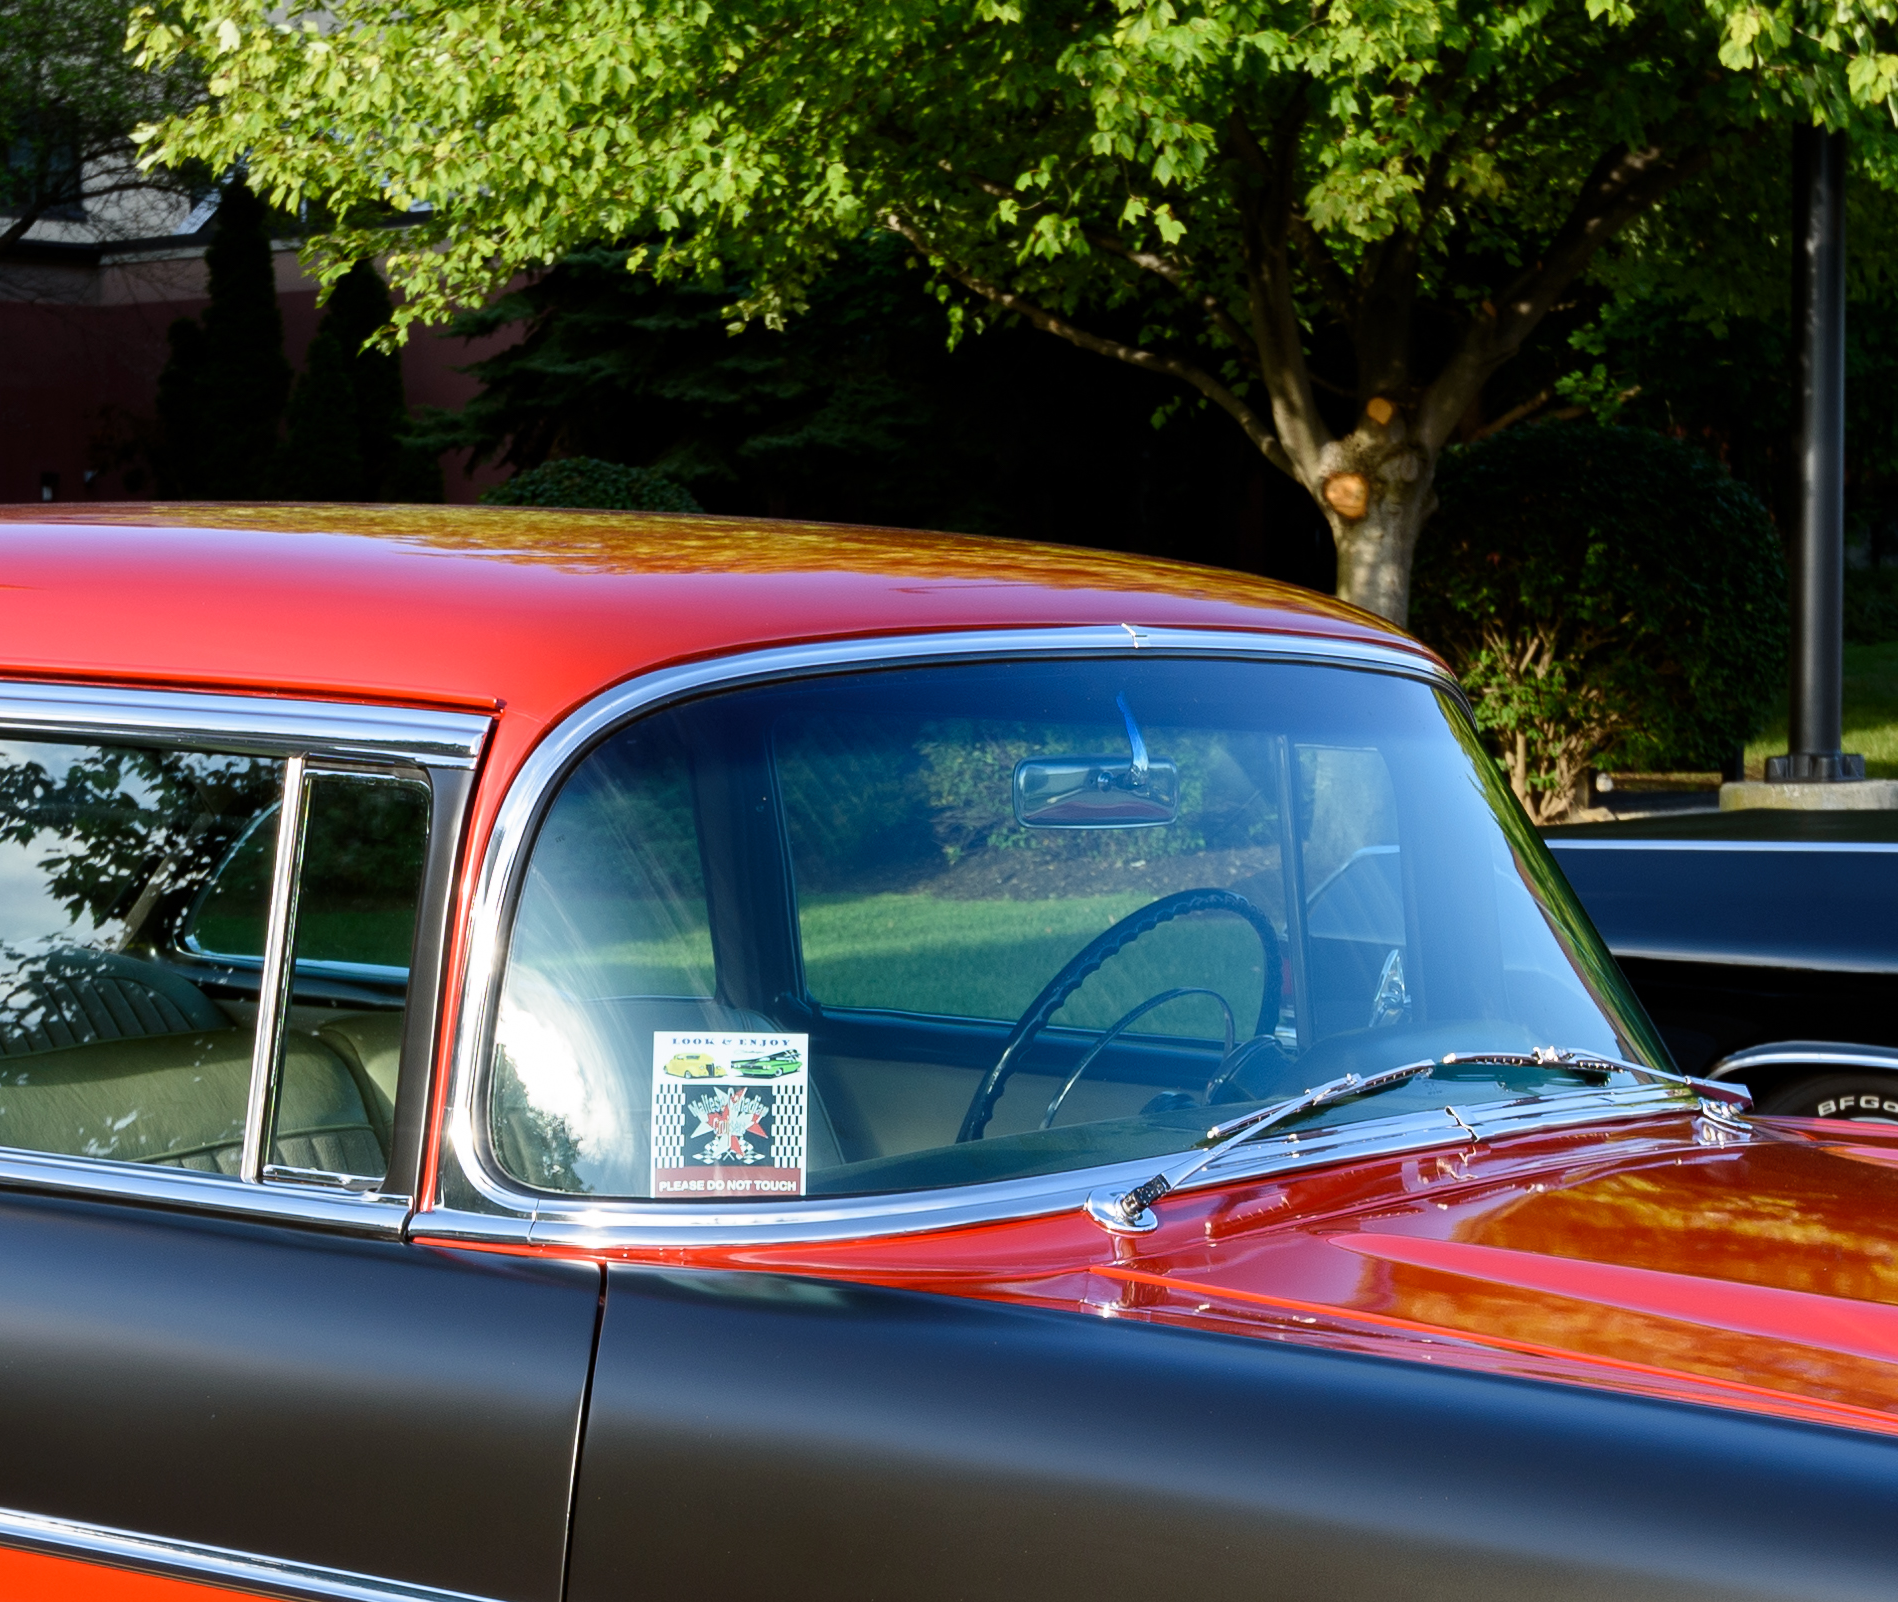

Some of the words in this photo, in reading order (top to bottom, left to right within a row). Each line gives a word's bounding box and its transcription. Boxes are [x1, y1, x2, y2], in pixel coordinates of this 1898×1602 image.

[672, 1037, 715, 1046] LOOK
[722, 1038, 732, 1046] &
[739, 1038, 791, 1047] ENJOY
[688, 1094, 726, 1117] Maltese
[727, 1087, 769, 1117] Canadian
[659, 1180, 705, 1192] PLEASE
[707, 1180, 725, 1191] DO
[727, 1180, 752, 1191] NOT
[754, 1180, 797, 1191] TOUCH
